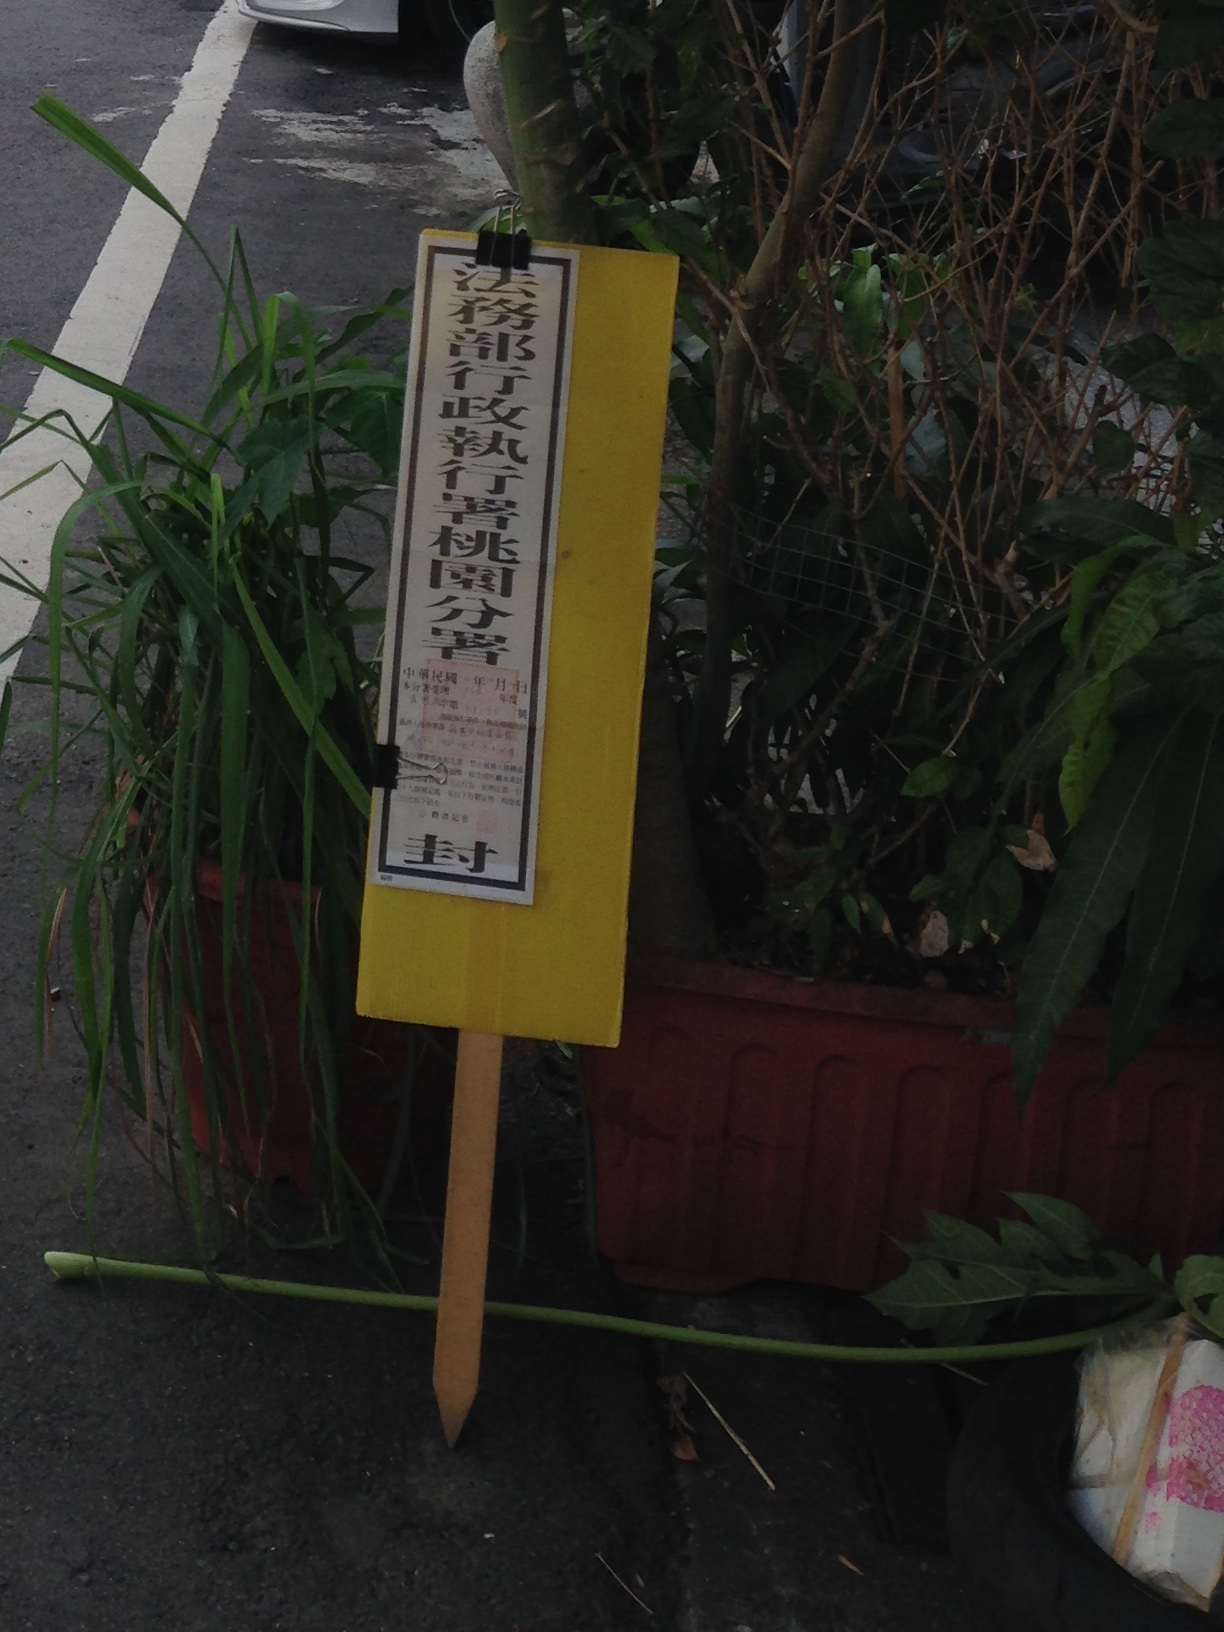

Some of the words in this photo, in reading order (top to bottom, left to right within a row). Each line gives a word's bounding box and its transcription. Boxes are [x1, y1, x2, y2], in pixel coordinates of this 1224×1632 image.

[421, 261, 540, 665] 法務部行政執行署桃園分署
[403, 666, 458, 685] 中華民國
[402, 833, 499, 874] 封
